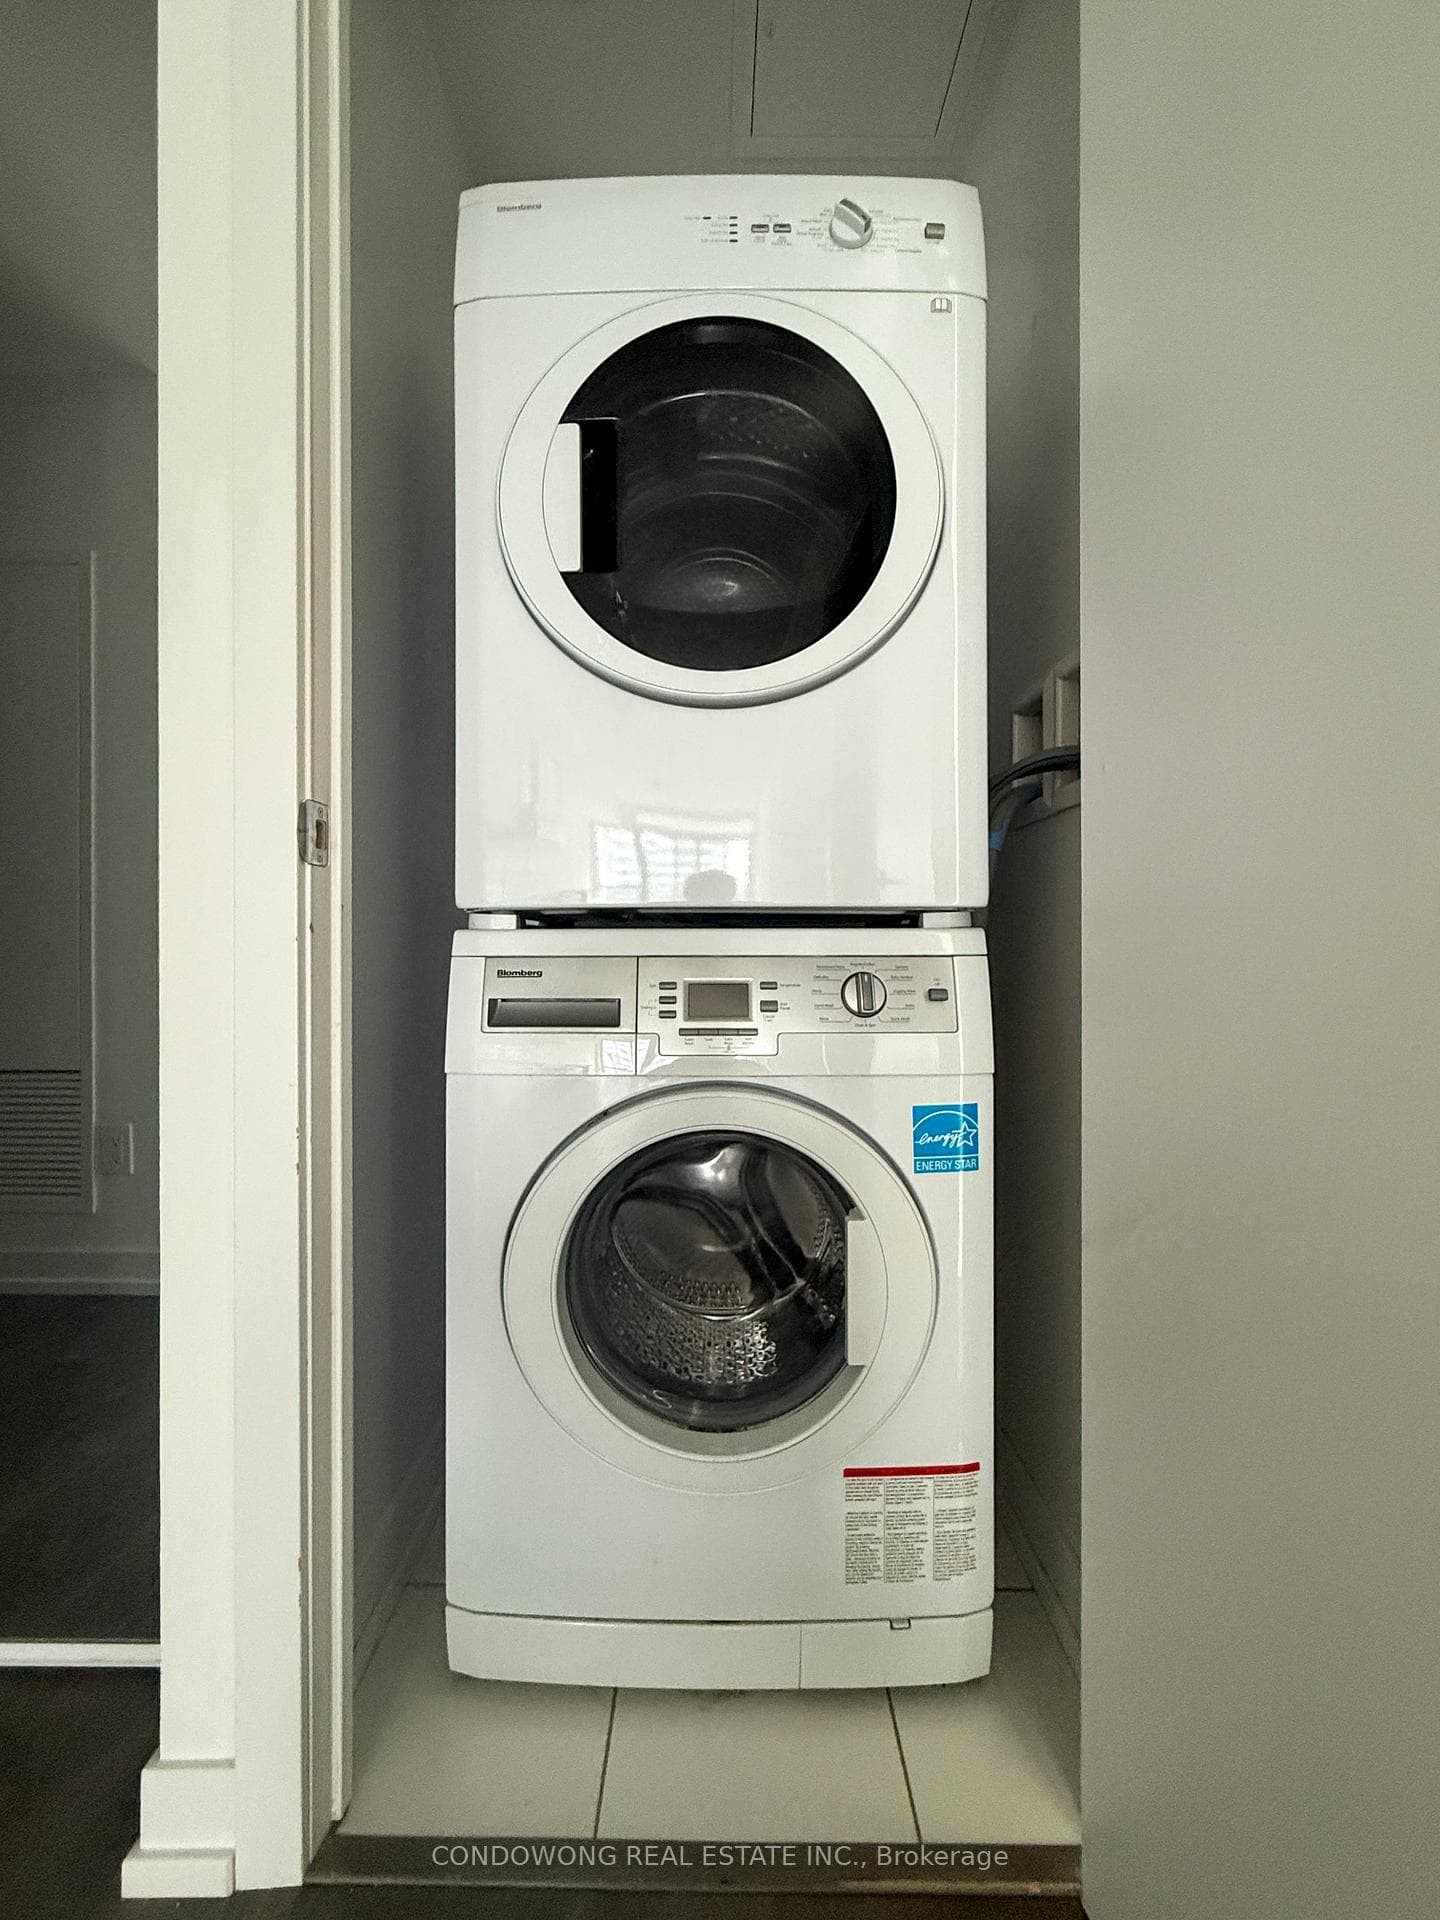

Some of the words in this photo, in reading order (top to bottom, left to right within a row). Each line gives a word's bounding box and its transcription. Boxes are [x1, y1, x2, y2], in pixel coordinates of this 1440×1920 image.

[497, 969, 543, 978] Blomberg
[916, 1160, 954, 1171] ENERGY
[954, 1158, 977, 1169] STAR
